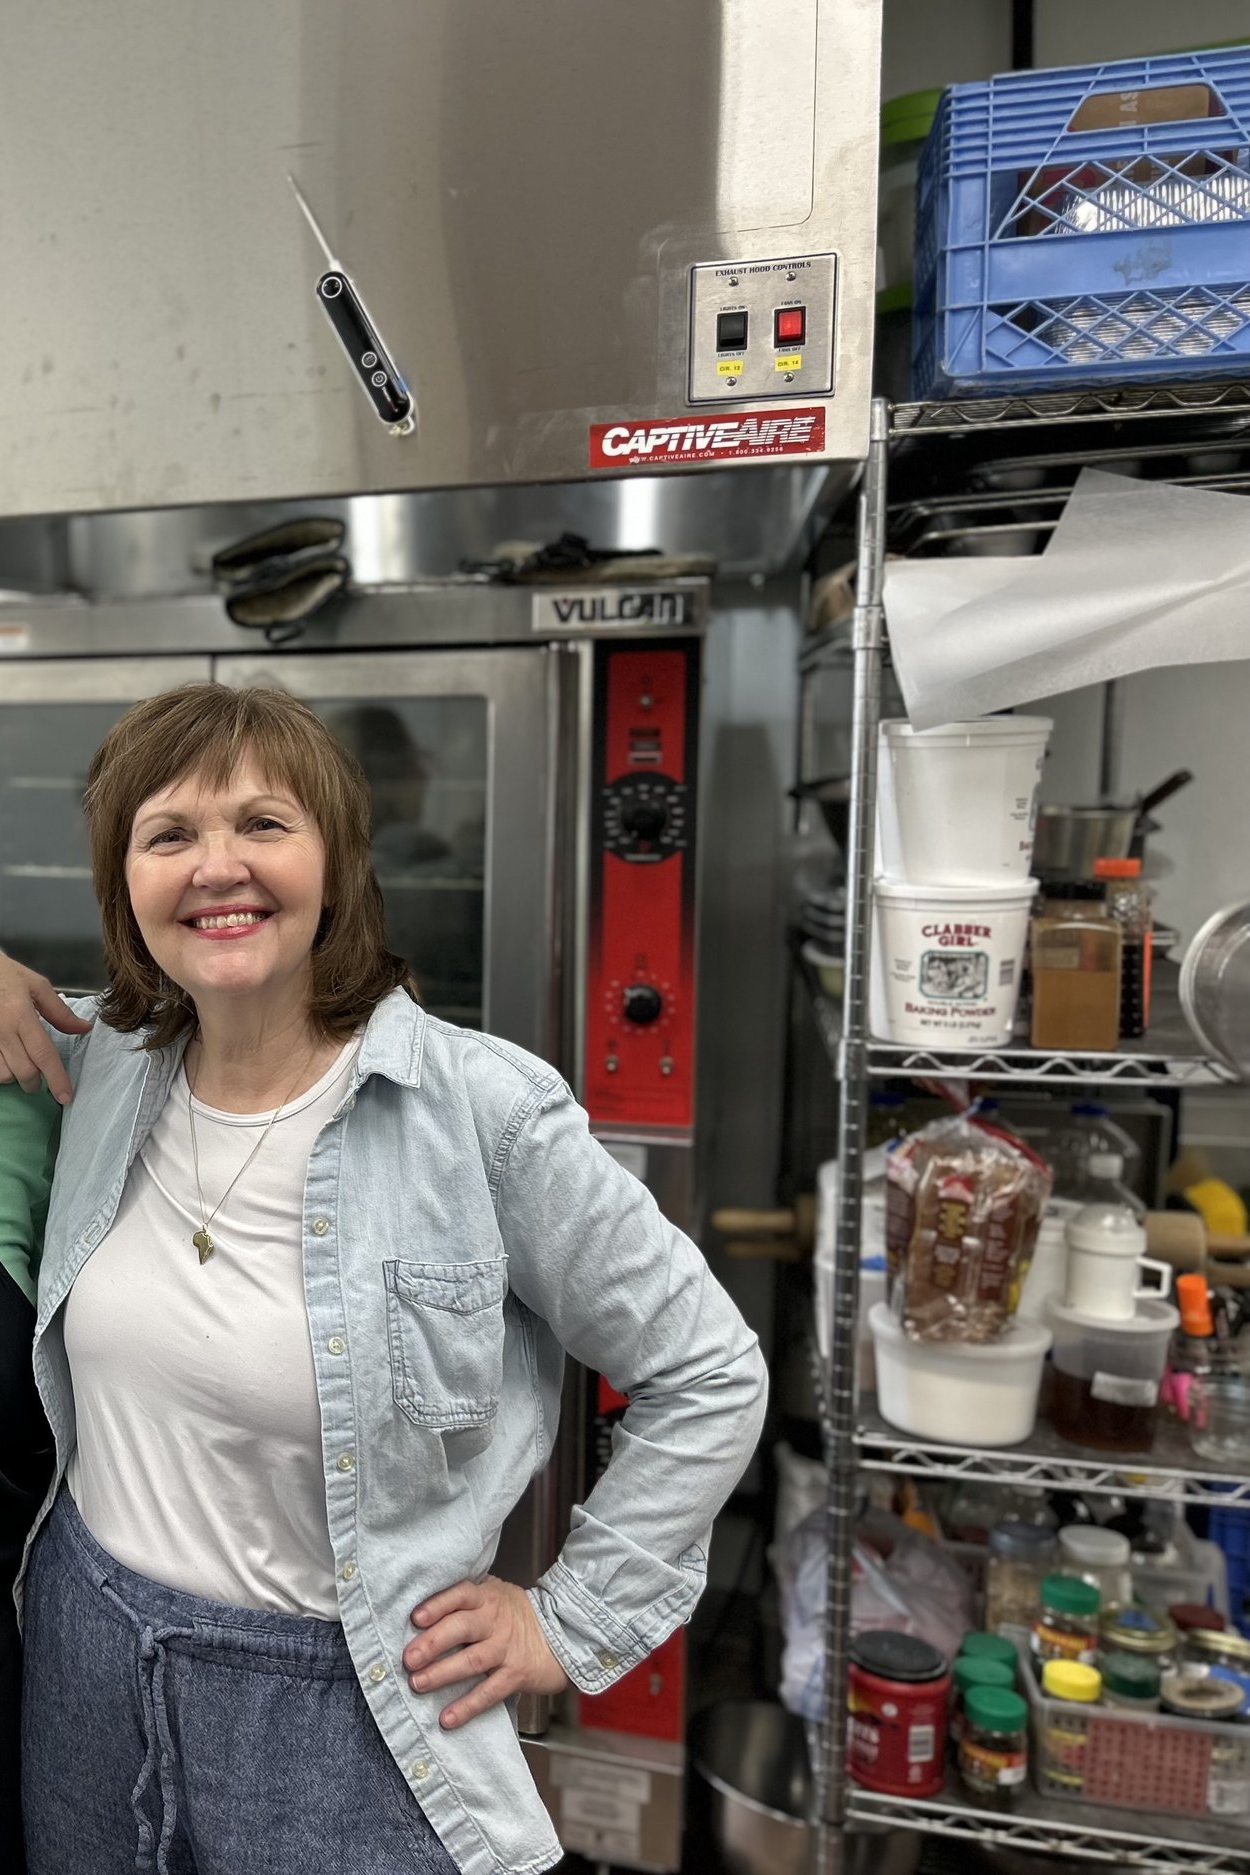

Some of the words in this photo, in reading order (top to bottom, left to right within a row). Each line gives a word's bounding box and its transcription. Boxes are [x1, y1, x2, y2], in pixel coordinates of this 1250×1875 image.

[715, 268, 747, 277] EXHAUST
[749, 265, 770, 274] HOOD
[772, 261, 812, 272] CONTROLS
[552, 594, 685, 623] VULCAN
[922, 924, 991, 938] CLABBER
[938, 936, 974, 947] GIRL
[905, 1002, 947, 1016] BAKING
[950, 1007, 996, 1018] POWDER
